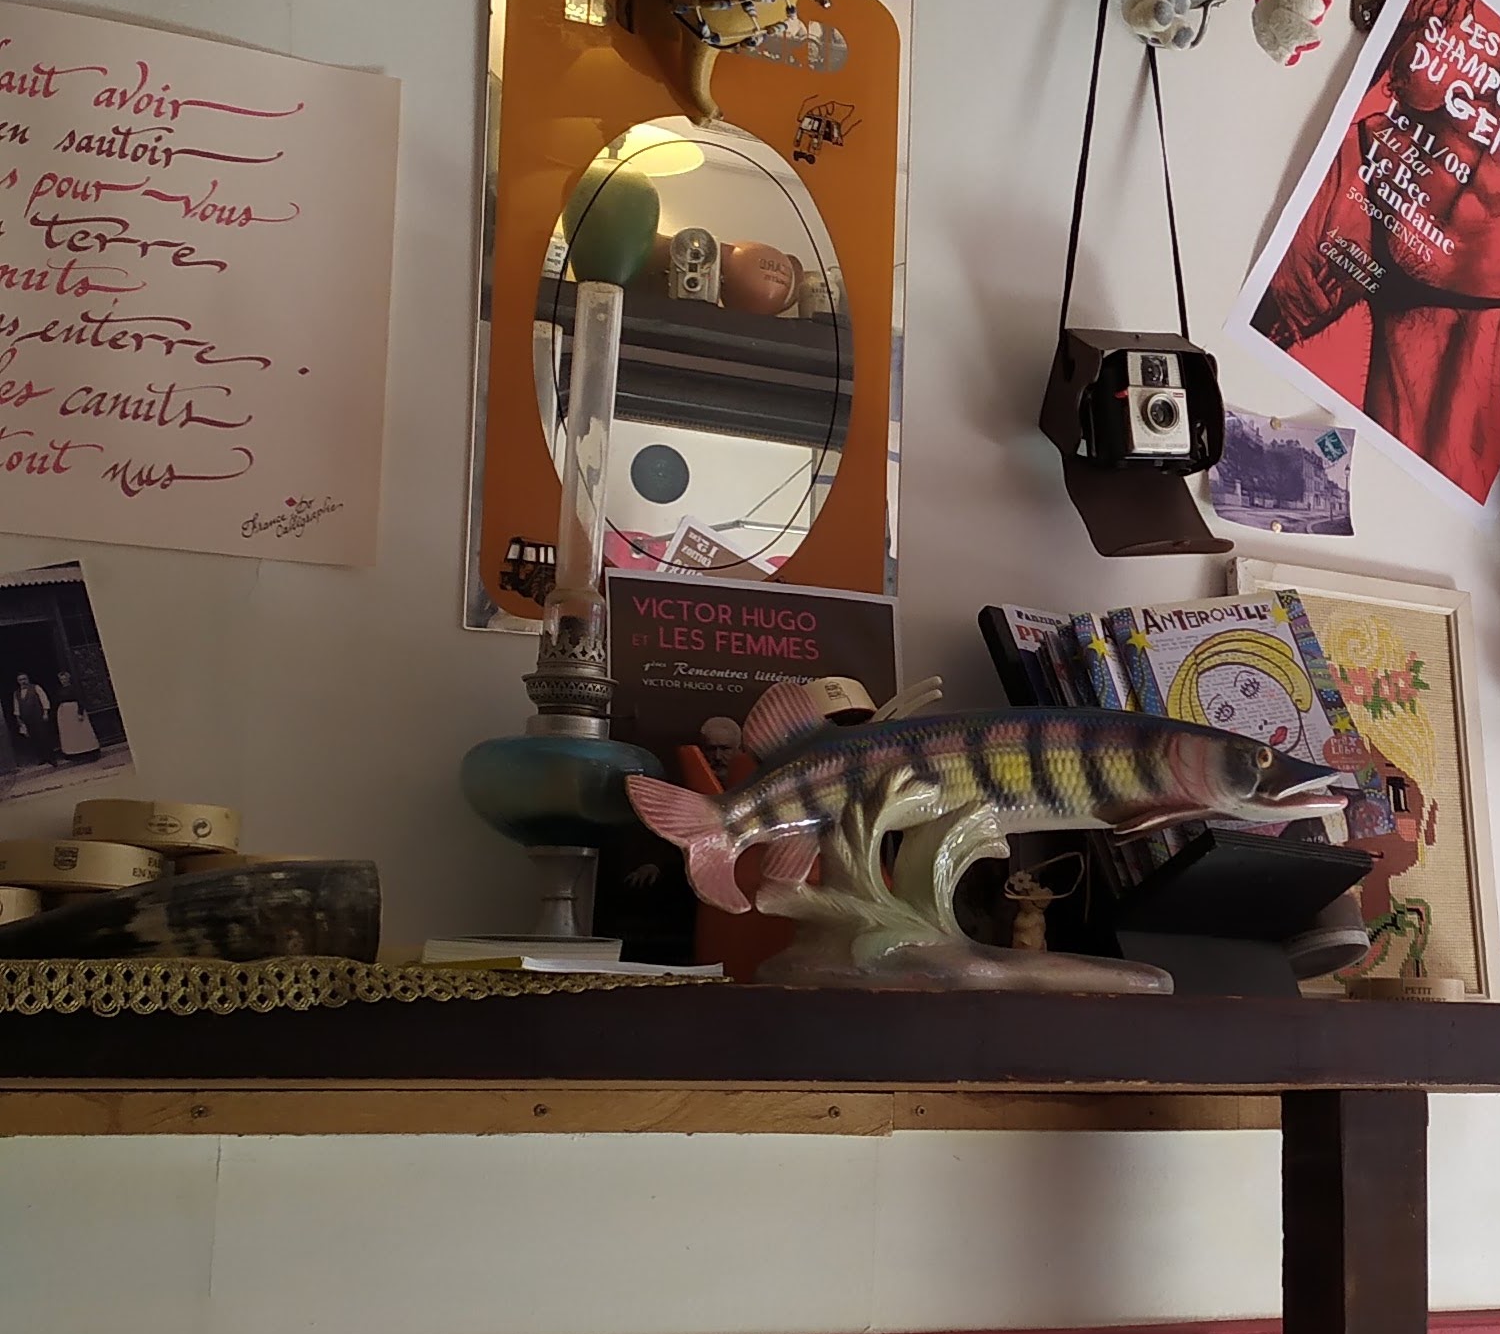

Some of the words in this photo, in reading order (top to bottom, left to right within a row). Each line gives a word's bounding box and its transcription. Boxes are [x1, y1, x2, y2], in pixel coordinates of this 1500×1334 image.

[1459, 13, 1500, 57] LES
[1409, 41, 1448, 85] DU
[55, 124, 283, 167] sautoir
[1373, 125, 1400, 157] Au
[1399, 143, 1434, 178] Bar
[1384, 97, 1408, 131] Le
[1411, 122, 1473, 185] 11/08
[24, 173, 148, 217] pour
[1363, 139, 1394, 176] Le
[1392, 166, 1432, 209] Bec
[1318, 240, 1381, 295] GRANVILLE
[59, 382, 253, 430] canuts
[632, 596, 733, 626] VICTOR
[741, 610, 818, 633] HUGO
[659, 627, 705, 652] LES
[714, 631, 820, 661] FEMMES
[642, 678, 681, 689] VICTOR
[683, 681, 714, 692] HUGO
[672, 660, 749, 681] Rencontres
